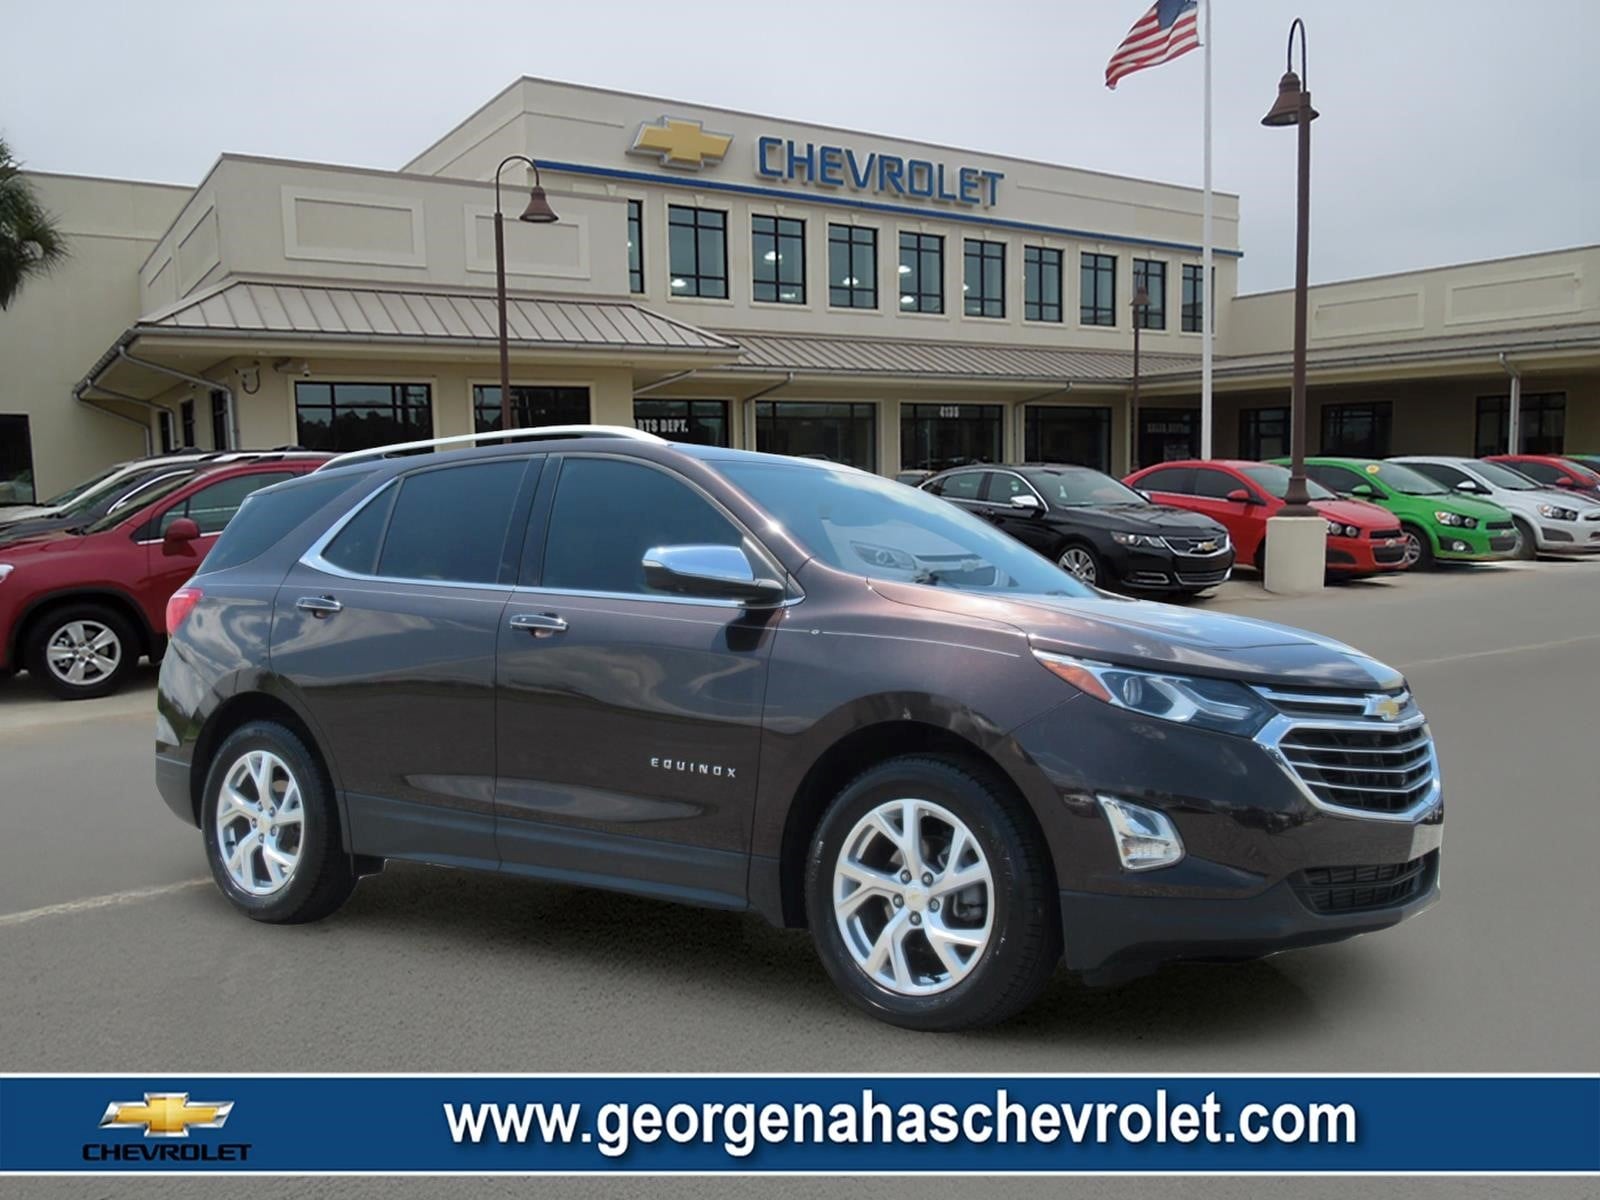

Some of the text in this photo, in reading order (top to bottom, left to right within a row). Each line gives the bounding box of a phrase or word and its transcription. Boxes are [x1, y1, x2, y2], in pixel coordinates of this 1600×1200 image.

[757, 136, 1005, 207] CHEVROLET
[660, 418, 689, 433] DEPT.
[650, 757, 737, 778] EQUINOX
